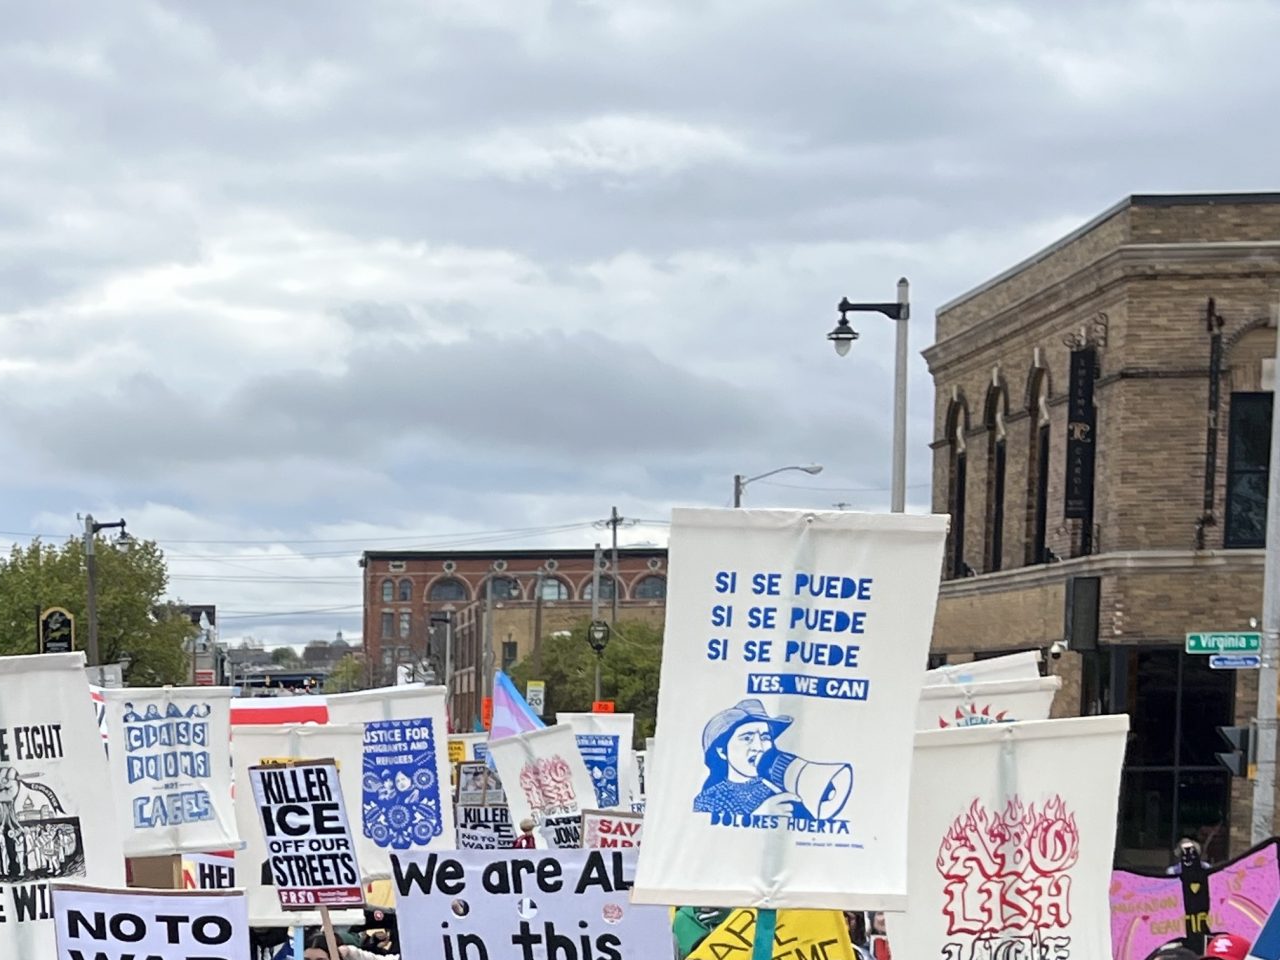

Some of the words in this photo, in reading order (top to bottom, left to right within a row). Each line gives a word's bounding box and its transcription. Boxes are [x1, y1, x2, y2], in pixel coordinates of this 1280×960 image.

[715, 571, 736, 594] SI
[752, 573, 781, 595] SE
[795, 573, 873, 600] PUEDE
[711, 605, 732, 627] SI
[748, 607, 777, 629] SE
[790, 607, 866, 634] PUEDE
[707, 639, 728, 661] SI
[743, 640, 772, 662] SE
[785, 640, 859, 668] PUEDE
[1200, 635, 1246, 649] Virginia
[795, 677, 818, 694] WE
[826, 680, 865, 698] CAN
[13, 724, 63, 760] FIGHT
[363, 729, 402, 743] USTICE
[405, 727, 430, 741] FOR
[261, 768, 332, 804] KILLER
[261, 803, 346, 836] ICE
[464, 808, 508, 823] KILLER
[711, 812, 779, 829] DOLORES
[786, 818, 850, 834] HUERTA
[269, 840, 306, 853] OFF
[308, 838, 350, 851] OUR
[272, 854, 357, 886] STREETS
[389, 853, 466, 896] We
[482, 857, 563, 894] are
[280, 891, 315, 903] FRSO
[67, 909, 146, 943] NO
[156, 914, 232, 945] TO
